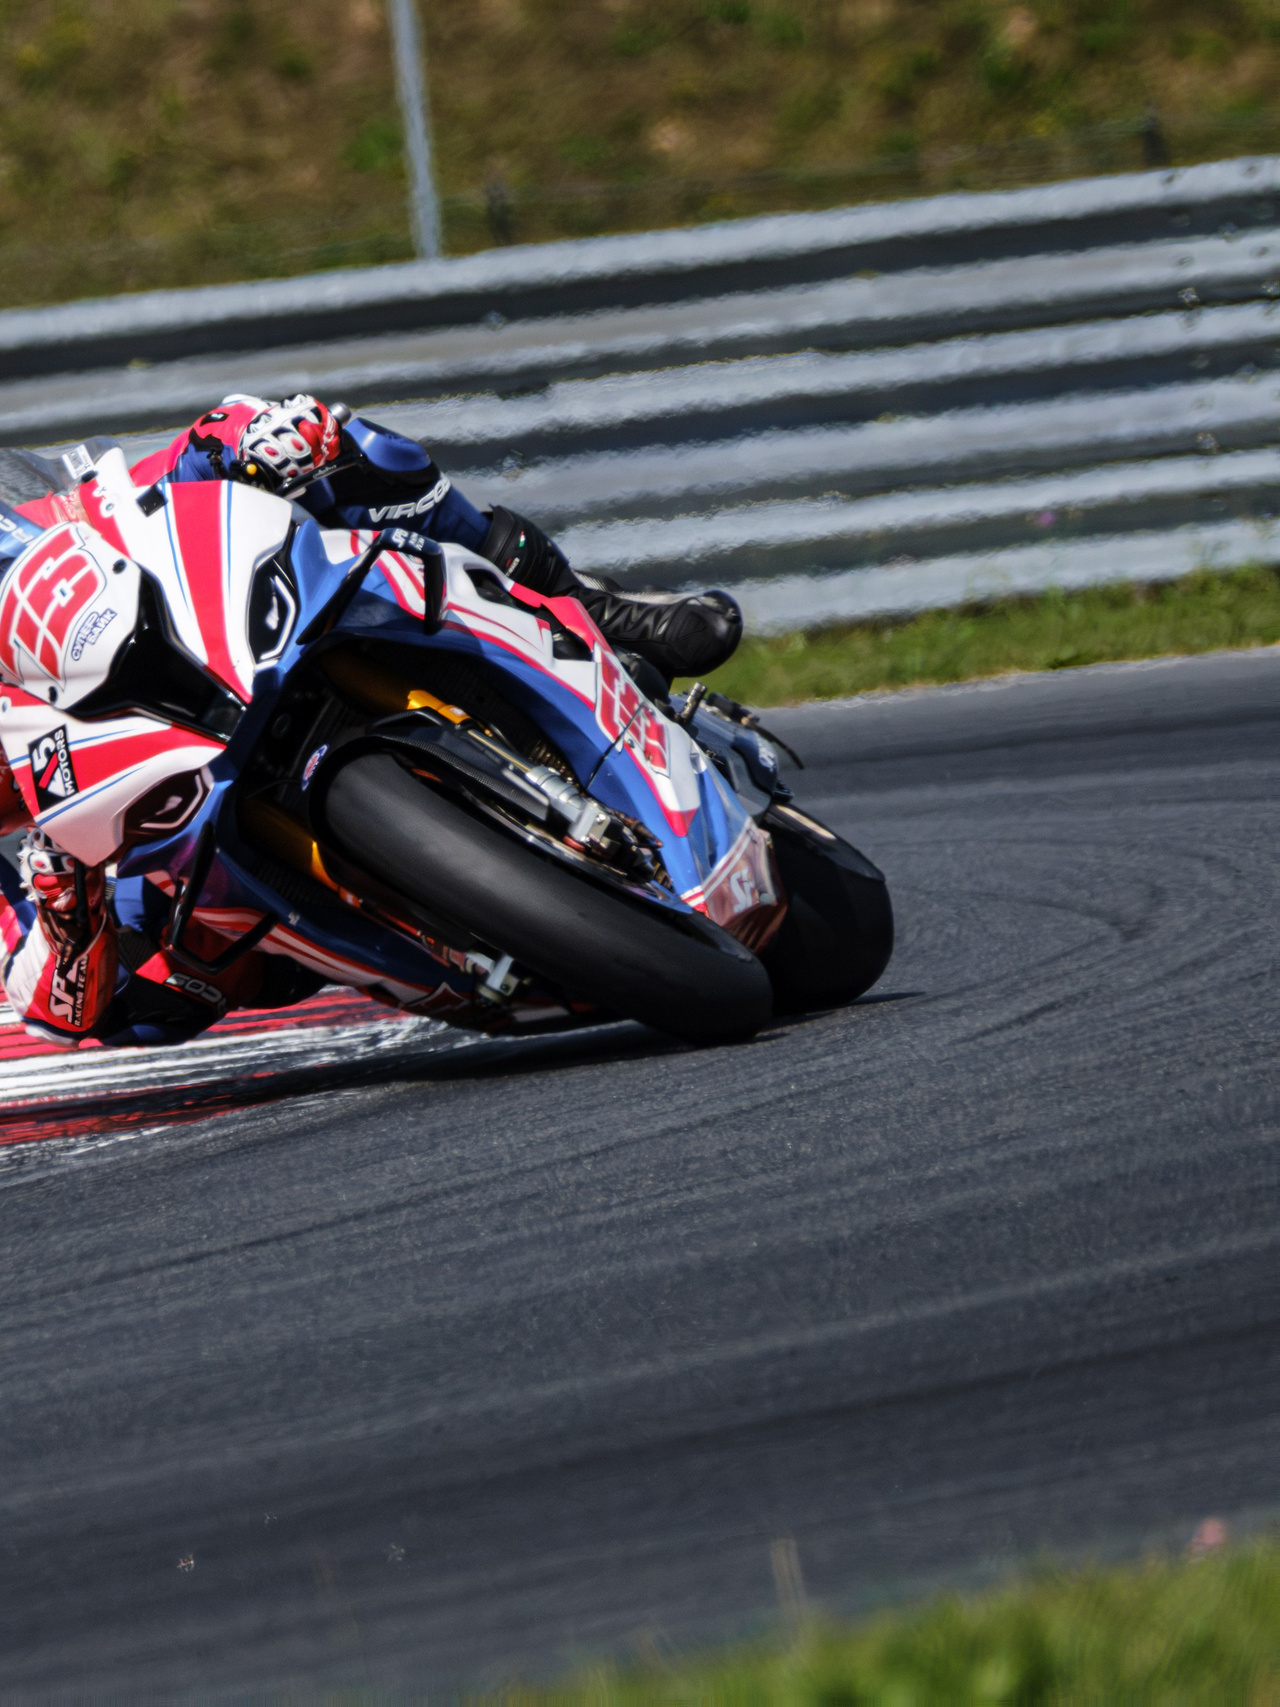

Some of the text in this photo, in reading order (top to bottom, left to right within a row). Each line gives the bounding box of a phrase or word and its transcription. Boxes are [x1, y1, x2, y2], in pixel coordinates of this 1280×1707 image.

[71, 609, 100, 662] СУПЕР
[87, 607, 117, 645] БАЙК
[54, 728, 76, 798] MOTORS
[74, 991, 86, 1027] RACING
